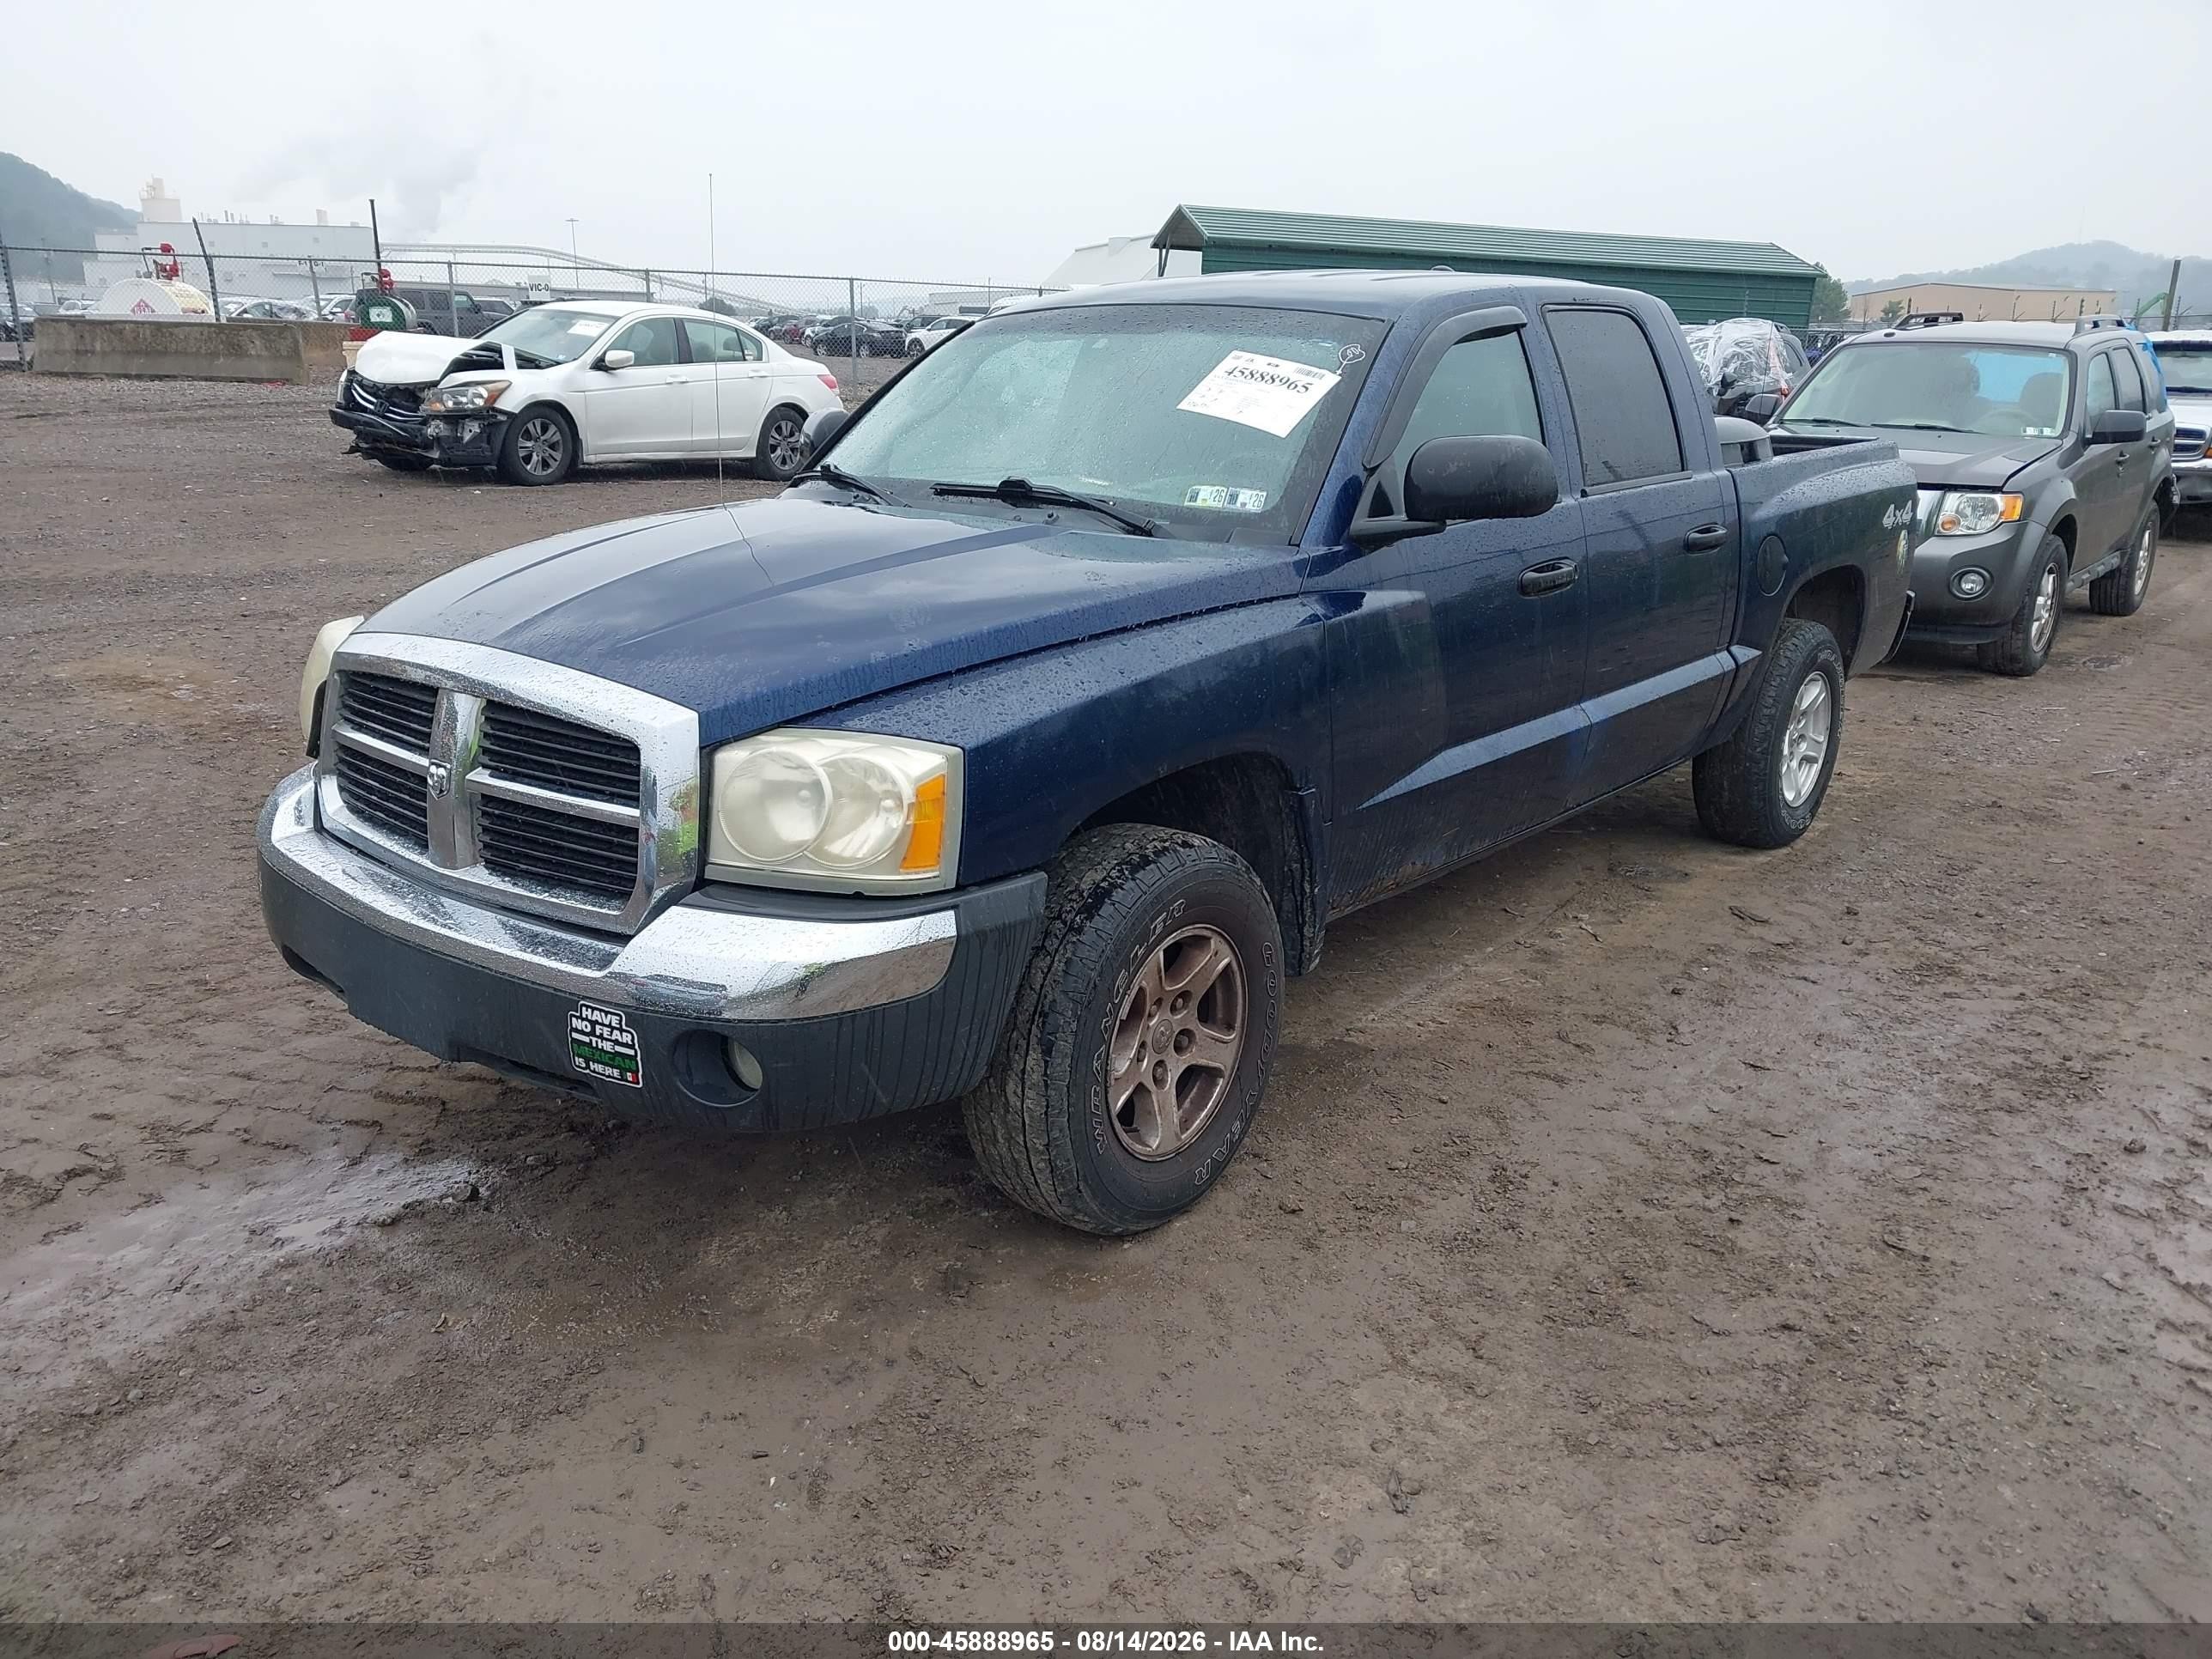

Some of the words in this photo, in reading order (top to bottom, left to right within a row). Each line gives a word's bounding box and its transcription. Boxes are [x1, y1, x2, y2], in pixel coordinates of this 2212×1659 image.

[1224, 366, 1314, 394] 45888965
[581, 1006, 621, 1029] HAVE
[1090, 899, 1186, 1155] WRANGLER
[571, 1018, 592, 1033] NO
[595, 1024, 633, 1045] FEAR
[589, 1036, 616, 1053] THE
[572, 1043, 636, 1070] MEXICAN
[574, 1056, 586, 1067] IS
[589, 1060, 623, 1079] HERE
[1194, 942, 1278, 1185] GOODYEAR
